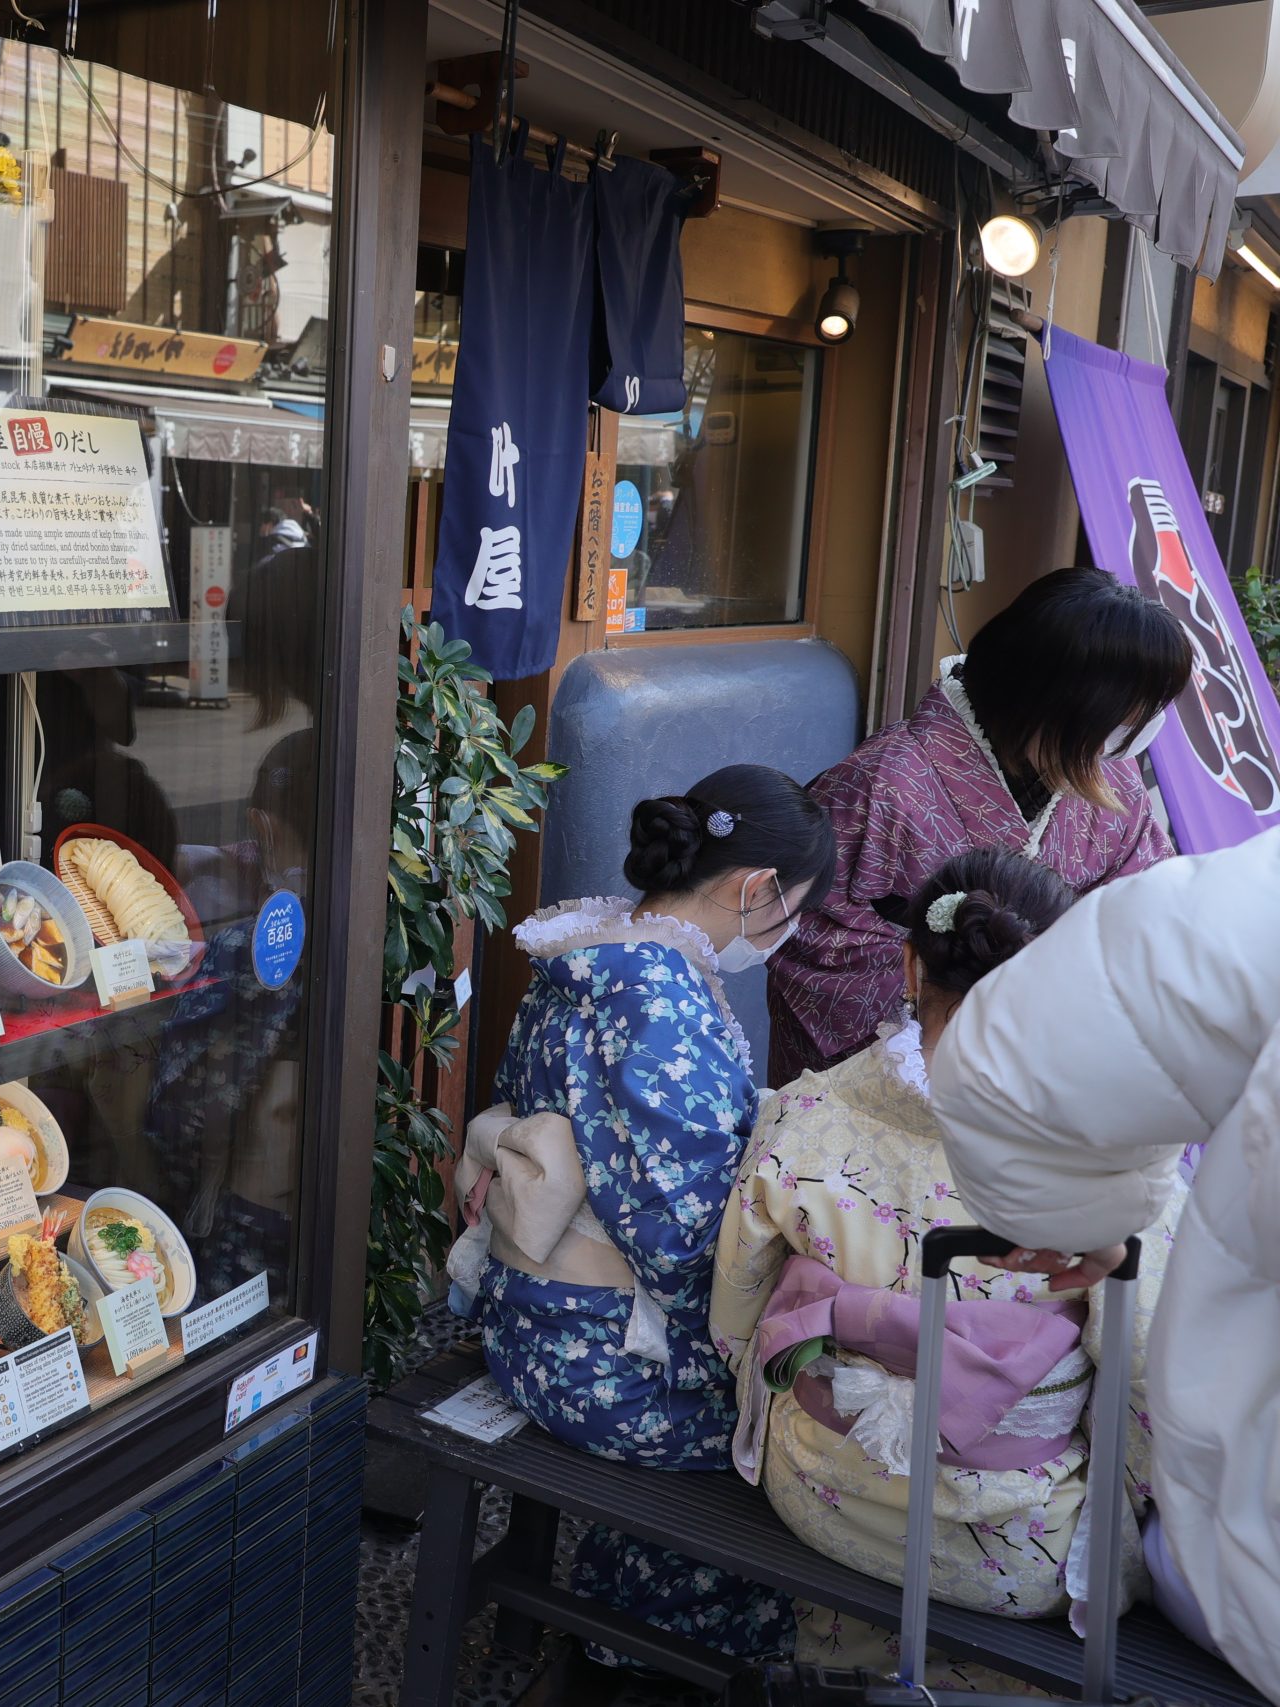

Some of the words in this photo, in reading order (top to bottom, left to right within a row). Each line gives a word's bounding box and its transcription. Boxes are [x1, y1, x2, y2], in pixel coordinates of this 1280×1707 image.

[1, 459, 21, 470] stock
[465, 422, 522, 609] 叶屋
[5, 529, 21, 537] made
[24, 529, 42, 539] using
[44, 529, 63, 539] ample
[65, 530, 91, 538] amounts
[92, 529, 98, 537] of
[100, 529, 112, 540] kelp
[12, 542, 28, 550] dried
[31, 542, 58, 552] sardines,
[61, 543, 72, 551] and
[73, 543, 89, 551] dried
[90, 543, 108, 552] bonito
[4, 556, 12, 565] be
[15, 557, 28, 565] sure
[31, 557, 37, 565] to
[39, 557, 48, 567] try
[59, 555, 109, 566] carefully-crafted
[268, 923, 292, 945] 百名店
[267, 1365, 277, 1375] VISA
